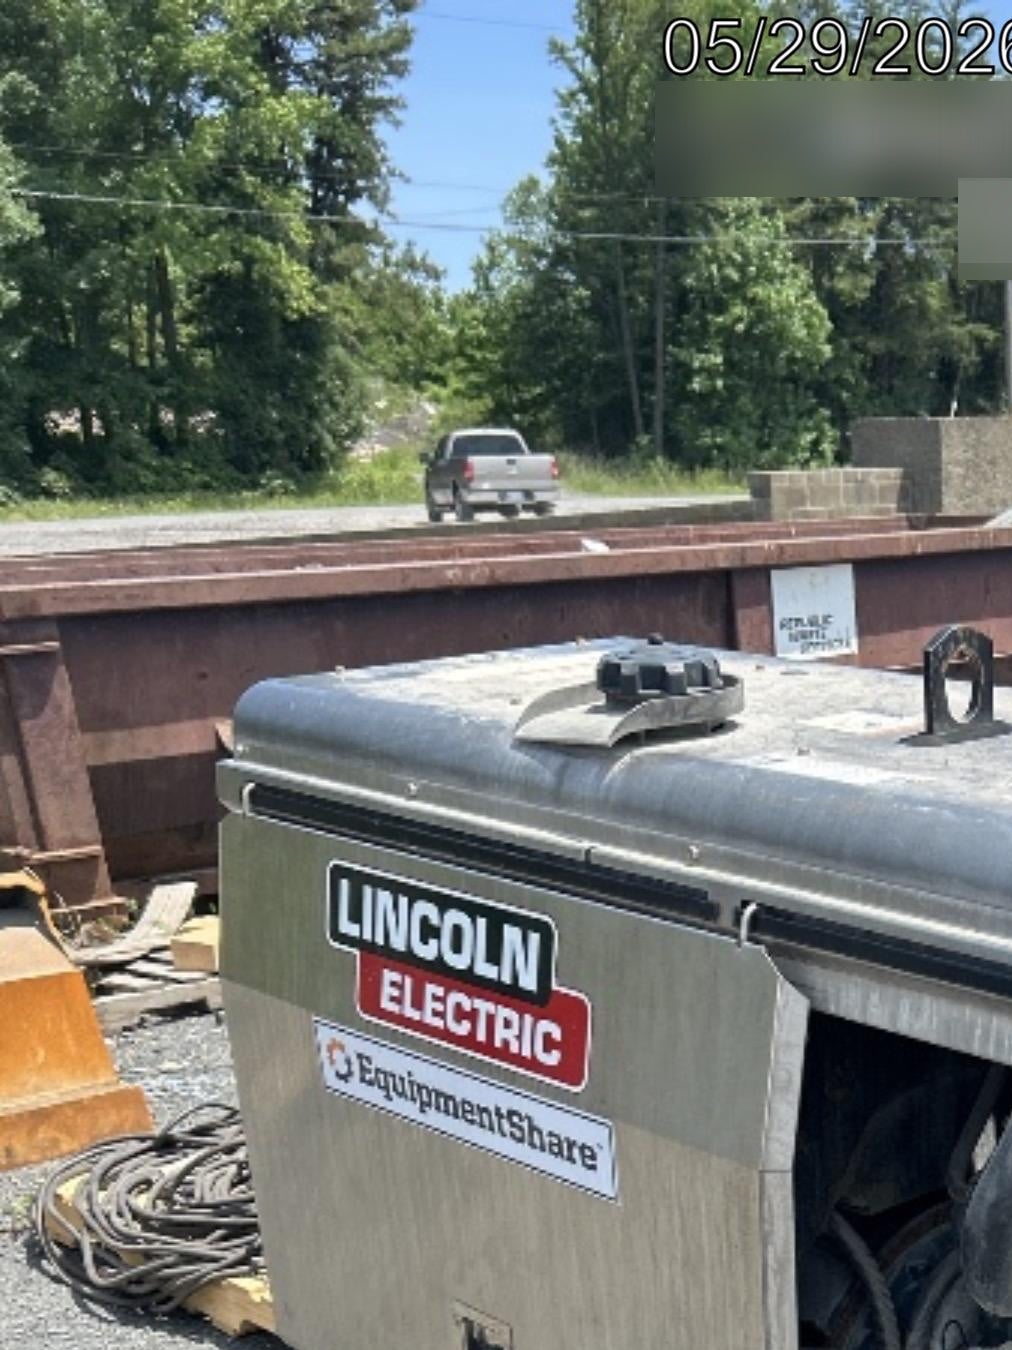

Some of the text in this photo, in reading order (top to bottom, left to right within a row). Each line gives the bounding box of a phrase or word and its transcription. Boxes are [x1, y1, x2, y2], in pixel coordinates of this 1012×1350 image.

[338, 877, 541, 994] LINCOLN
[378, 967, 563, 1067] ELECTRIC
[356, 1052, 600, 1173] EquipmentShare
